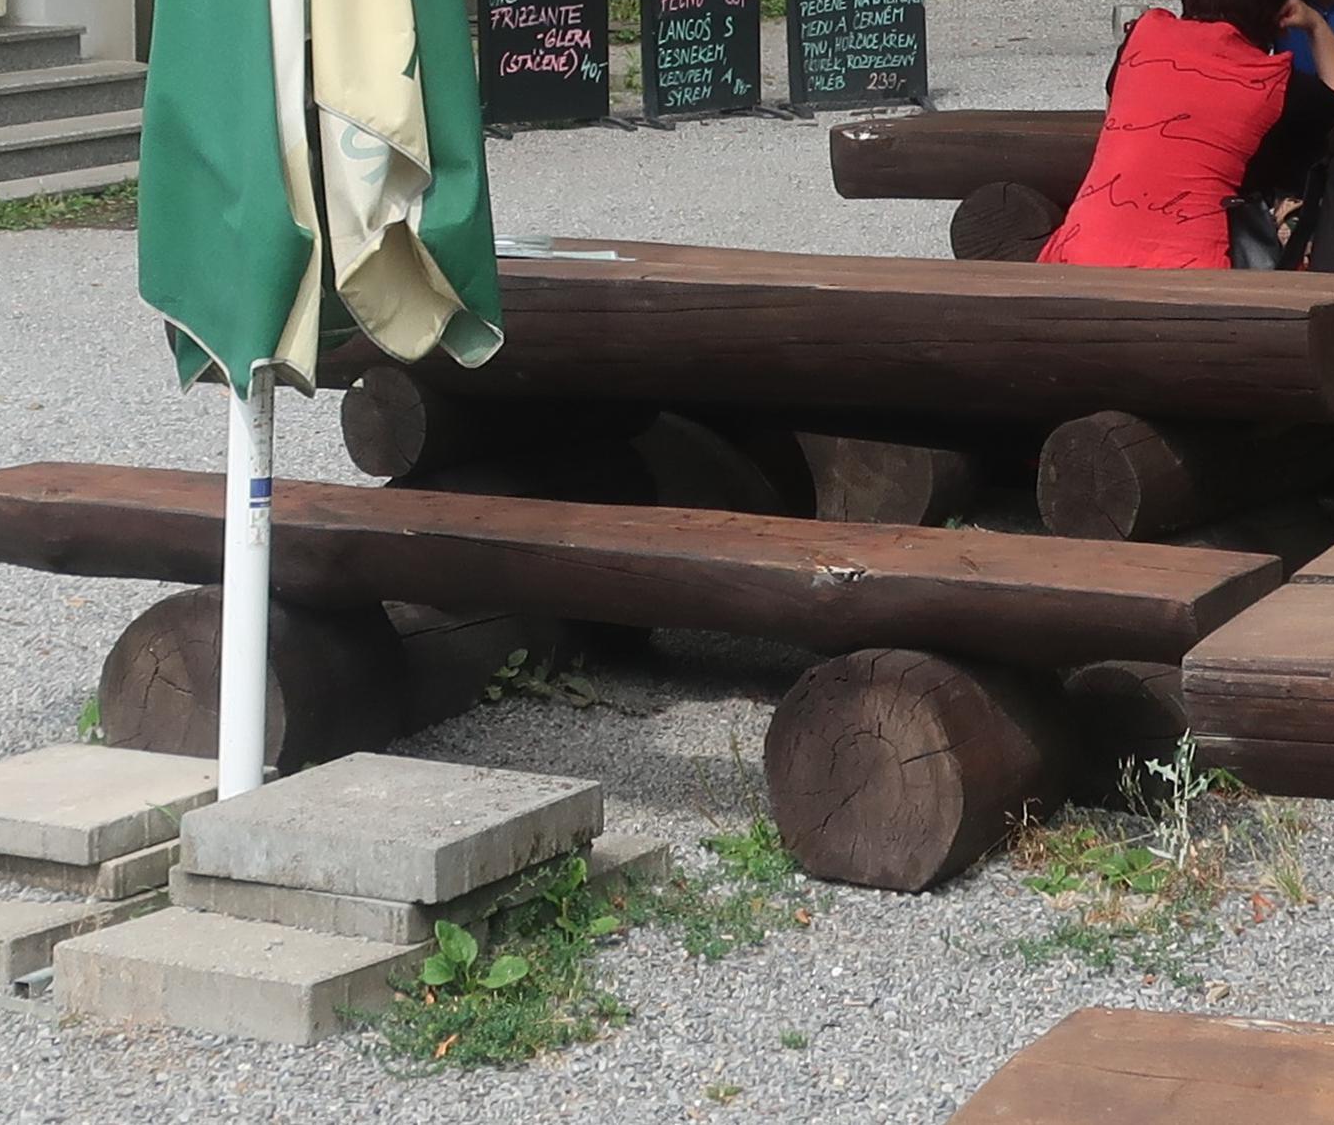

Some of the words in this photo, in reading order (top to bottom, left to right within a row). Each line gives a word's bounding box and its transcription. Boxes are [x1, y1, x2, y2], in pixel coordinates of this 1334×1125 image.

[490, 4, 584, 29] FRIZZANTE
[835, 16, 847, 33] A
[853, 7, 904, 31] ČERNÉM
[657, 12, 711, 45] LANGOŠ
[724, 16, 733, 38] S
[847, 51, 917, 70] ROZPEČENÝ
[721, 67, 733, 84] A
[807, 73, 846, 92] CHLÉB
[664, 84, 713, 107] SÝREM
